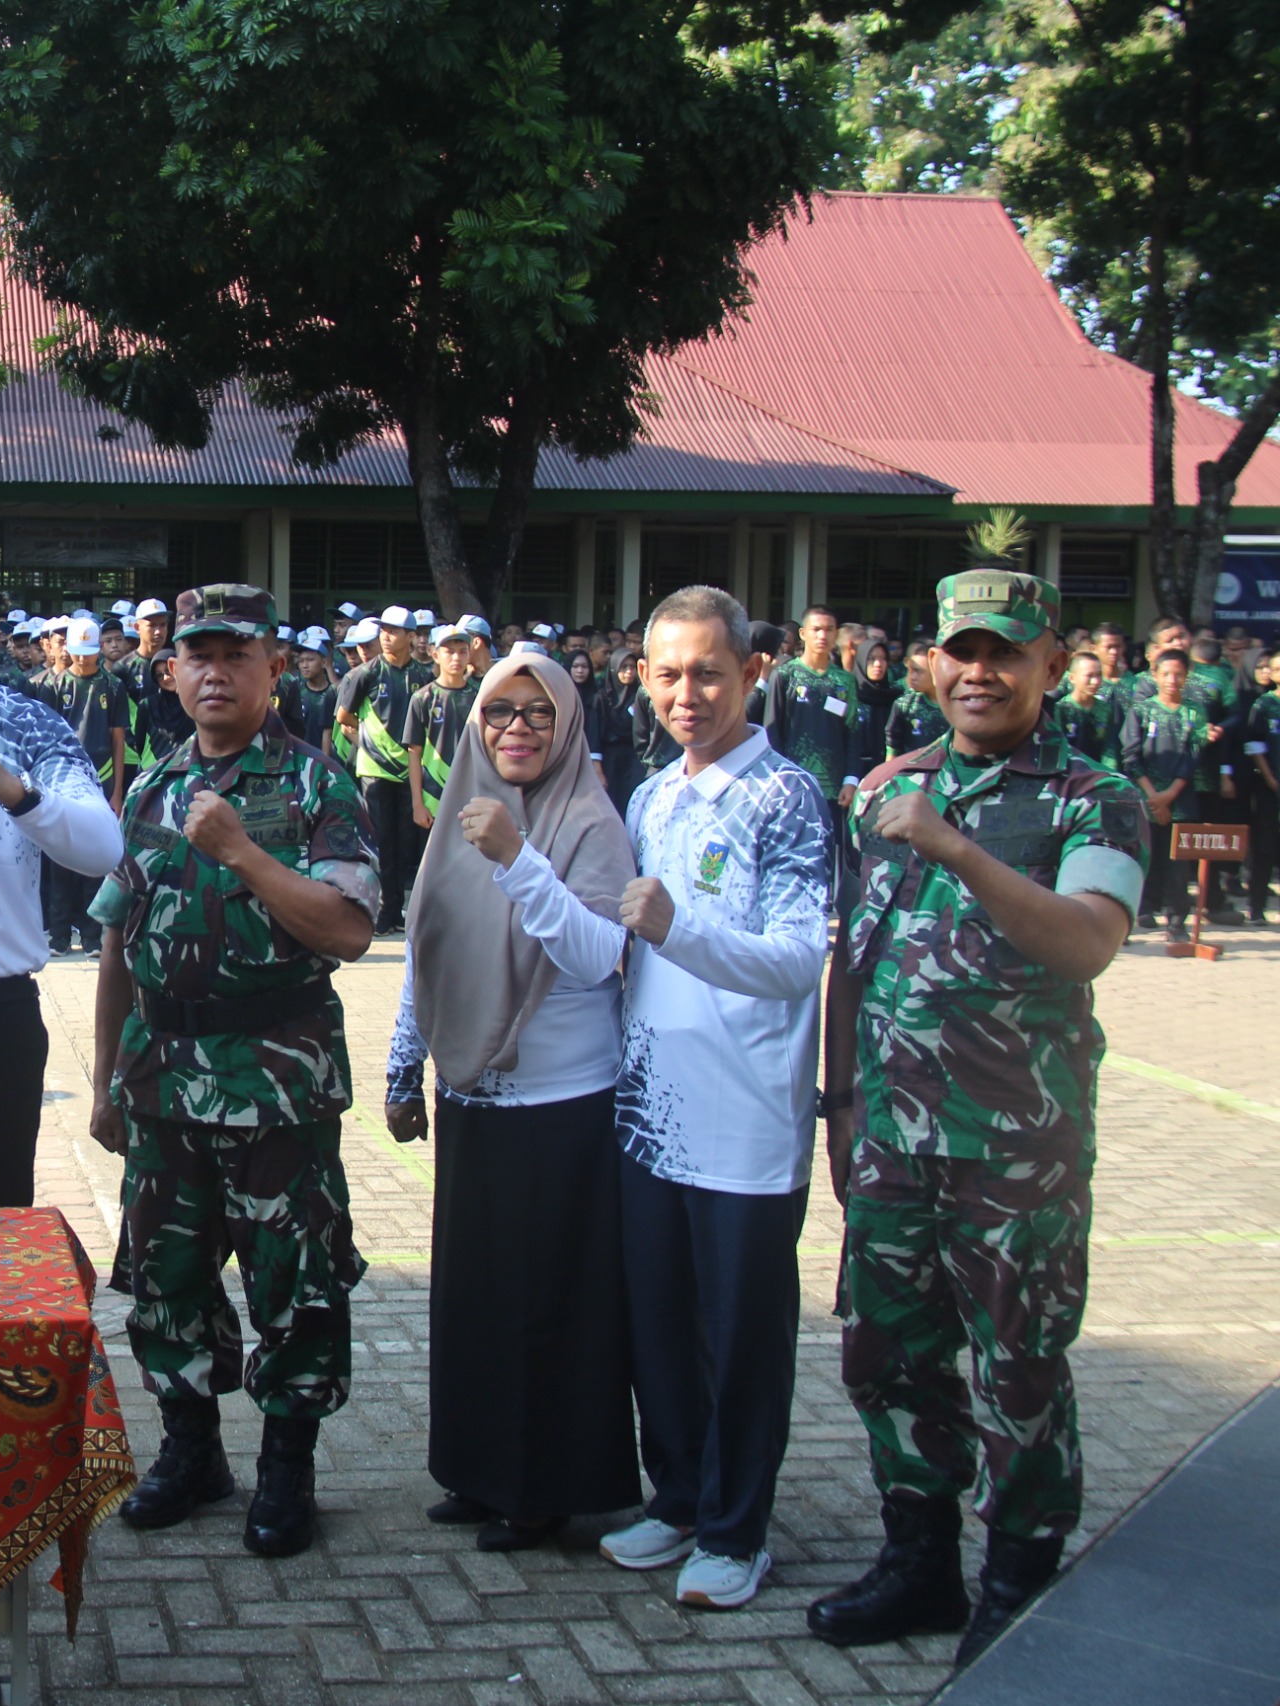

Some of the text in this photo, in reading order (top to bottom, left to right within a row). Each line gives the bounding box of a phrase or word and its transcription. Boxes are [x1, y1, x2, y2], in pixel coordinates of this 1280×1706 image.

[1256, 580, 1280, 597] W
[271, 828, 298, 841] AD
[1178, 832, 1240, 851] X TITL 1
